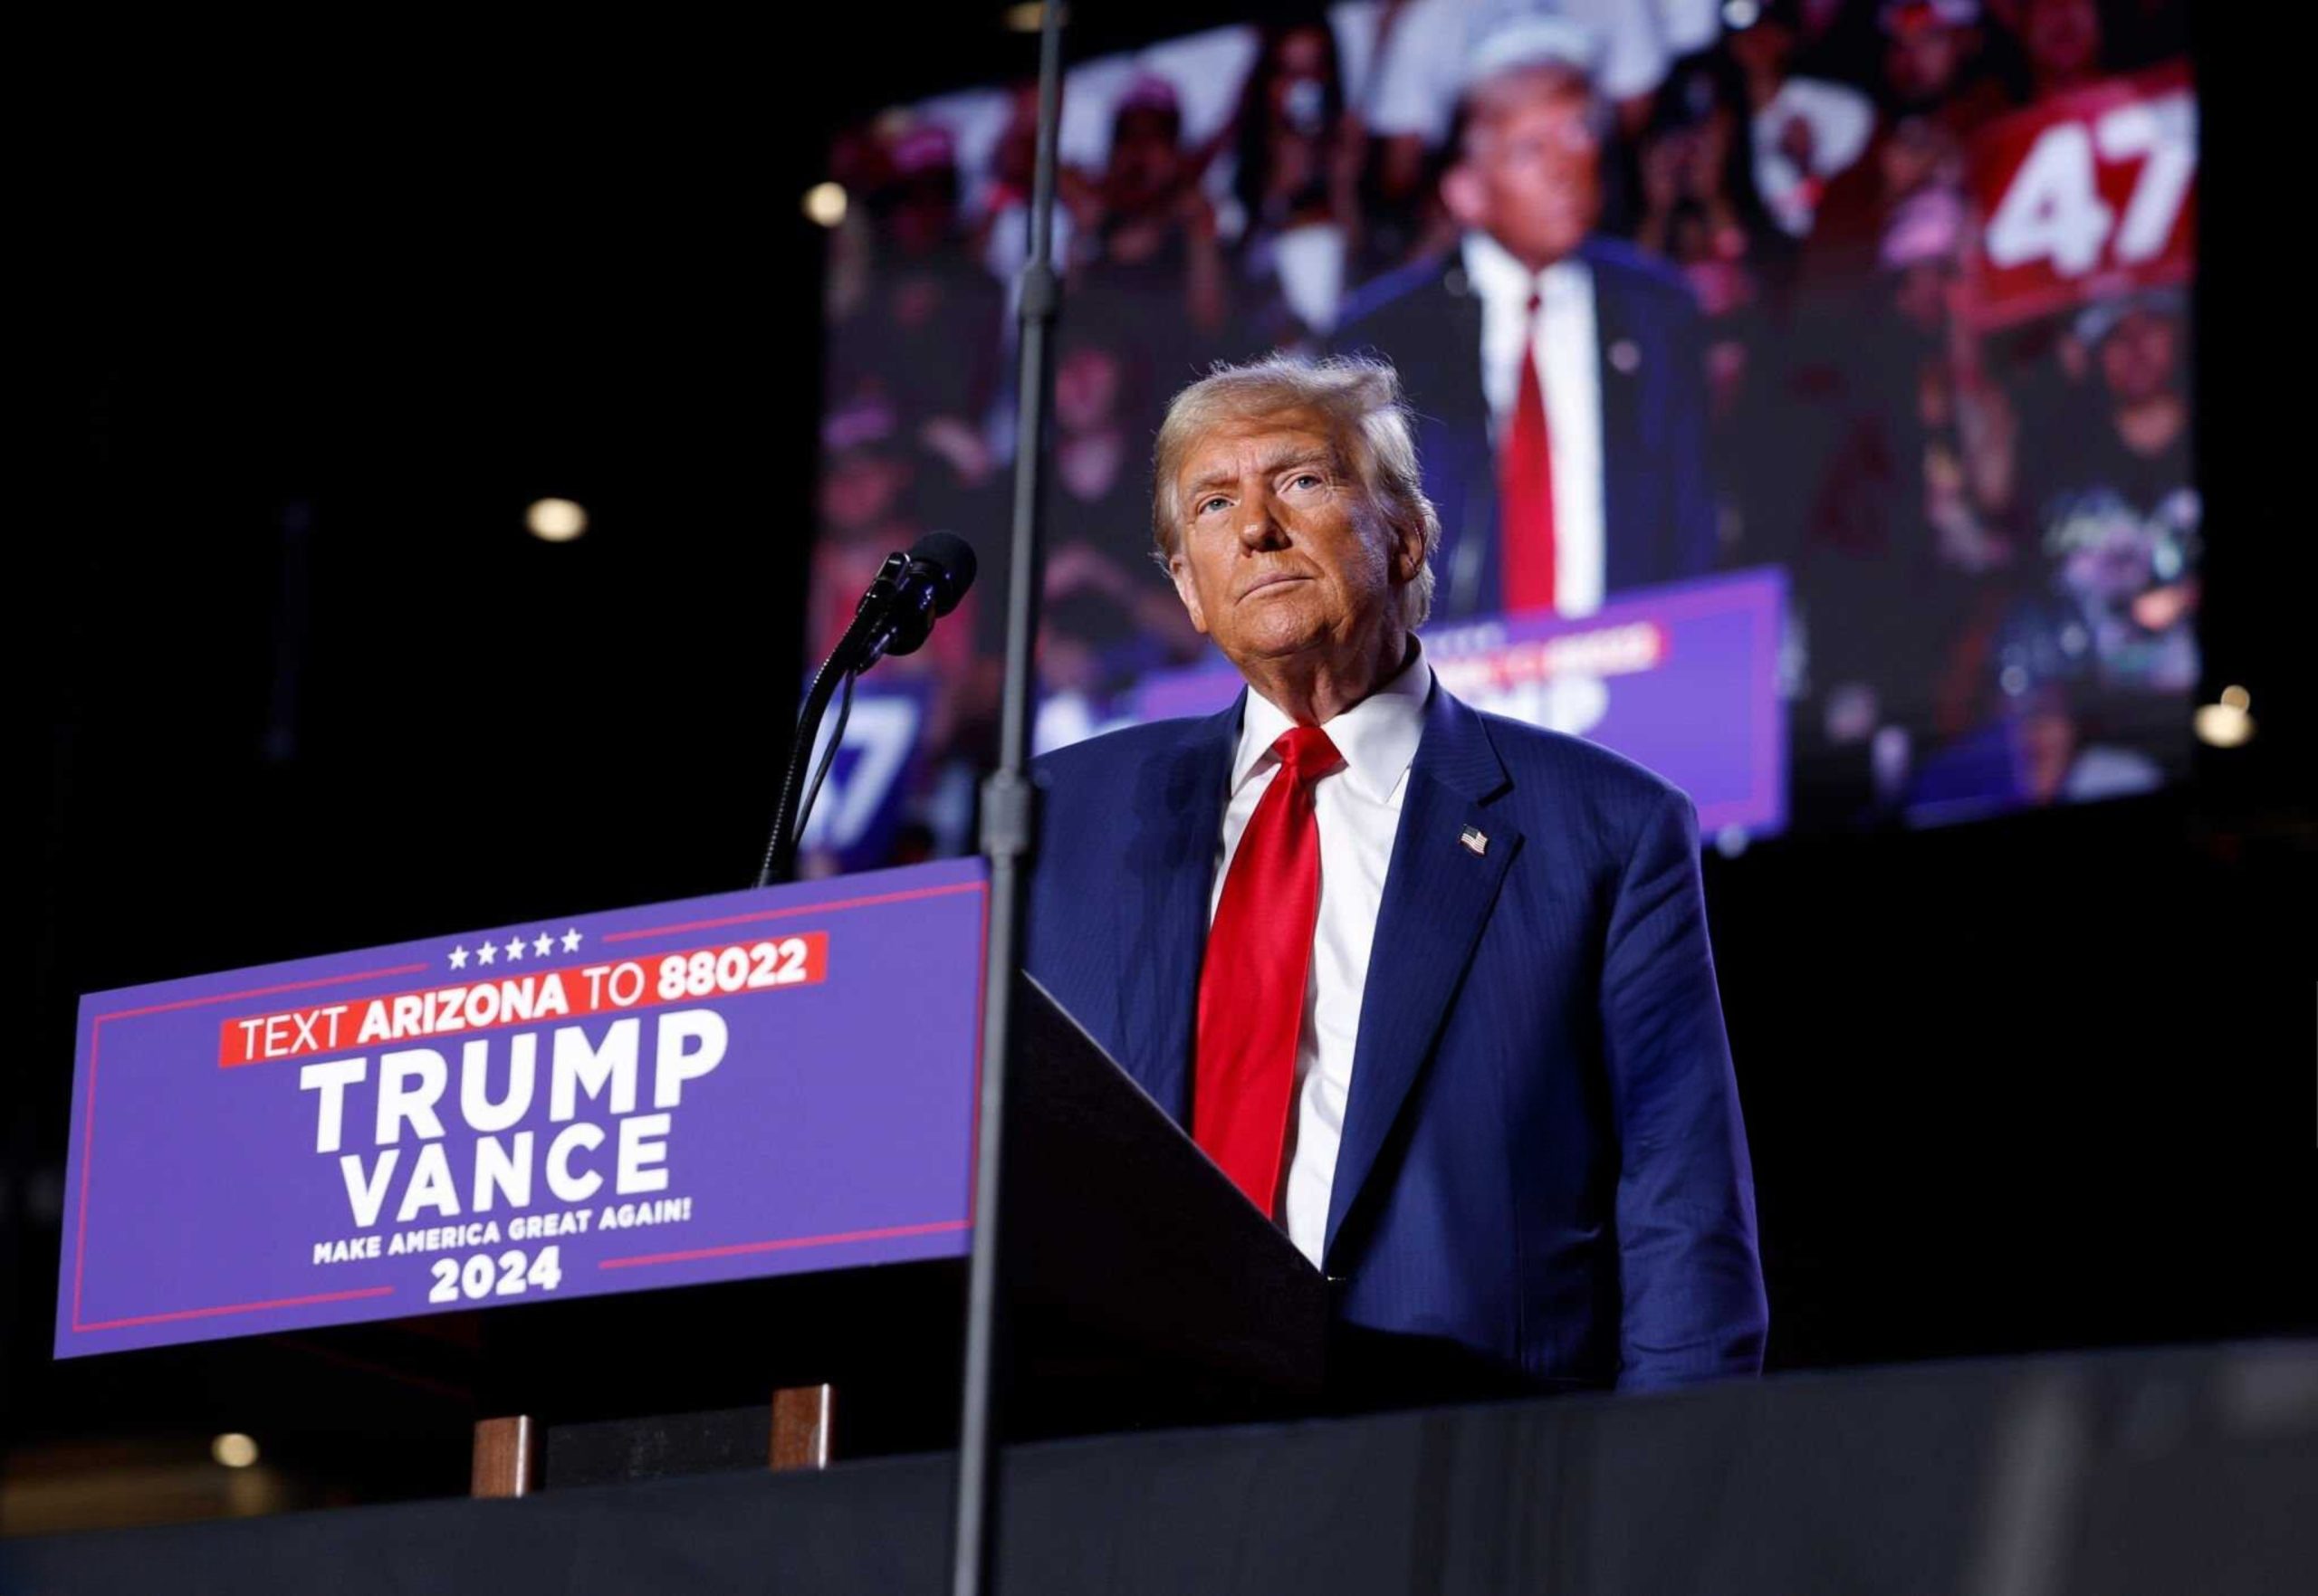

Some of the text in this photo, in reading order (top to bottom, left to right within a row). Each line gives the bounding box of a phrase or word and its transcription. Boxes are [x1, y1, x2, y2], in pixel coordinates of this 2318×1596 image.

[1987, 92, 2198, 277] 47
[239, 937, 808, 1060] TEXT ARIZONA TO 88022
[300, 1008, 730, 1153] TRUMP
[340, 1113, 672, 1228] VANCE
[312, 1197, 692, 1265] MAKE AMERICA GREAT AGAIN!
[428, 1245, 563, 1304] 2024
